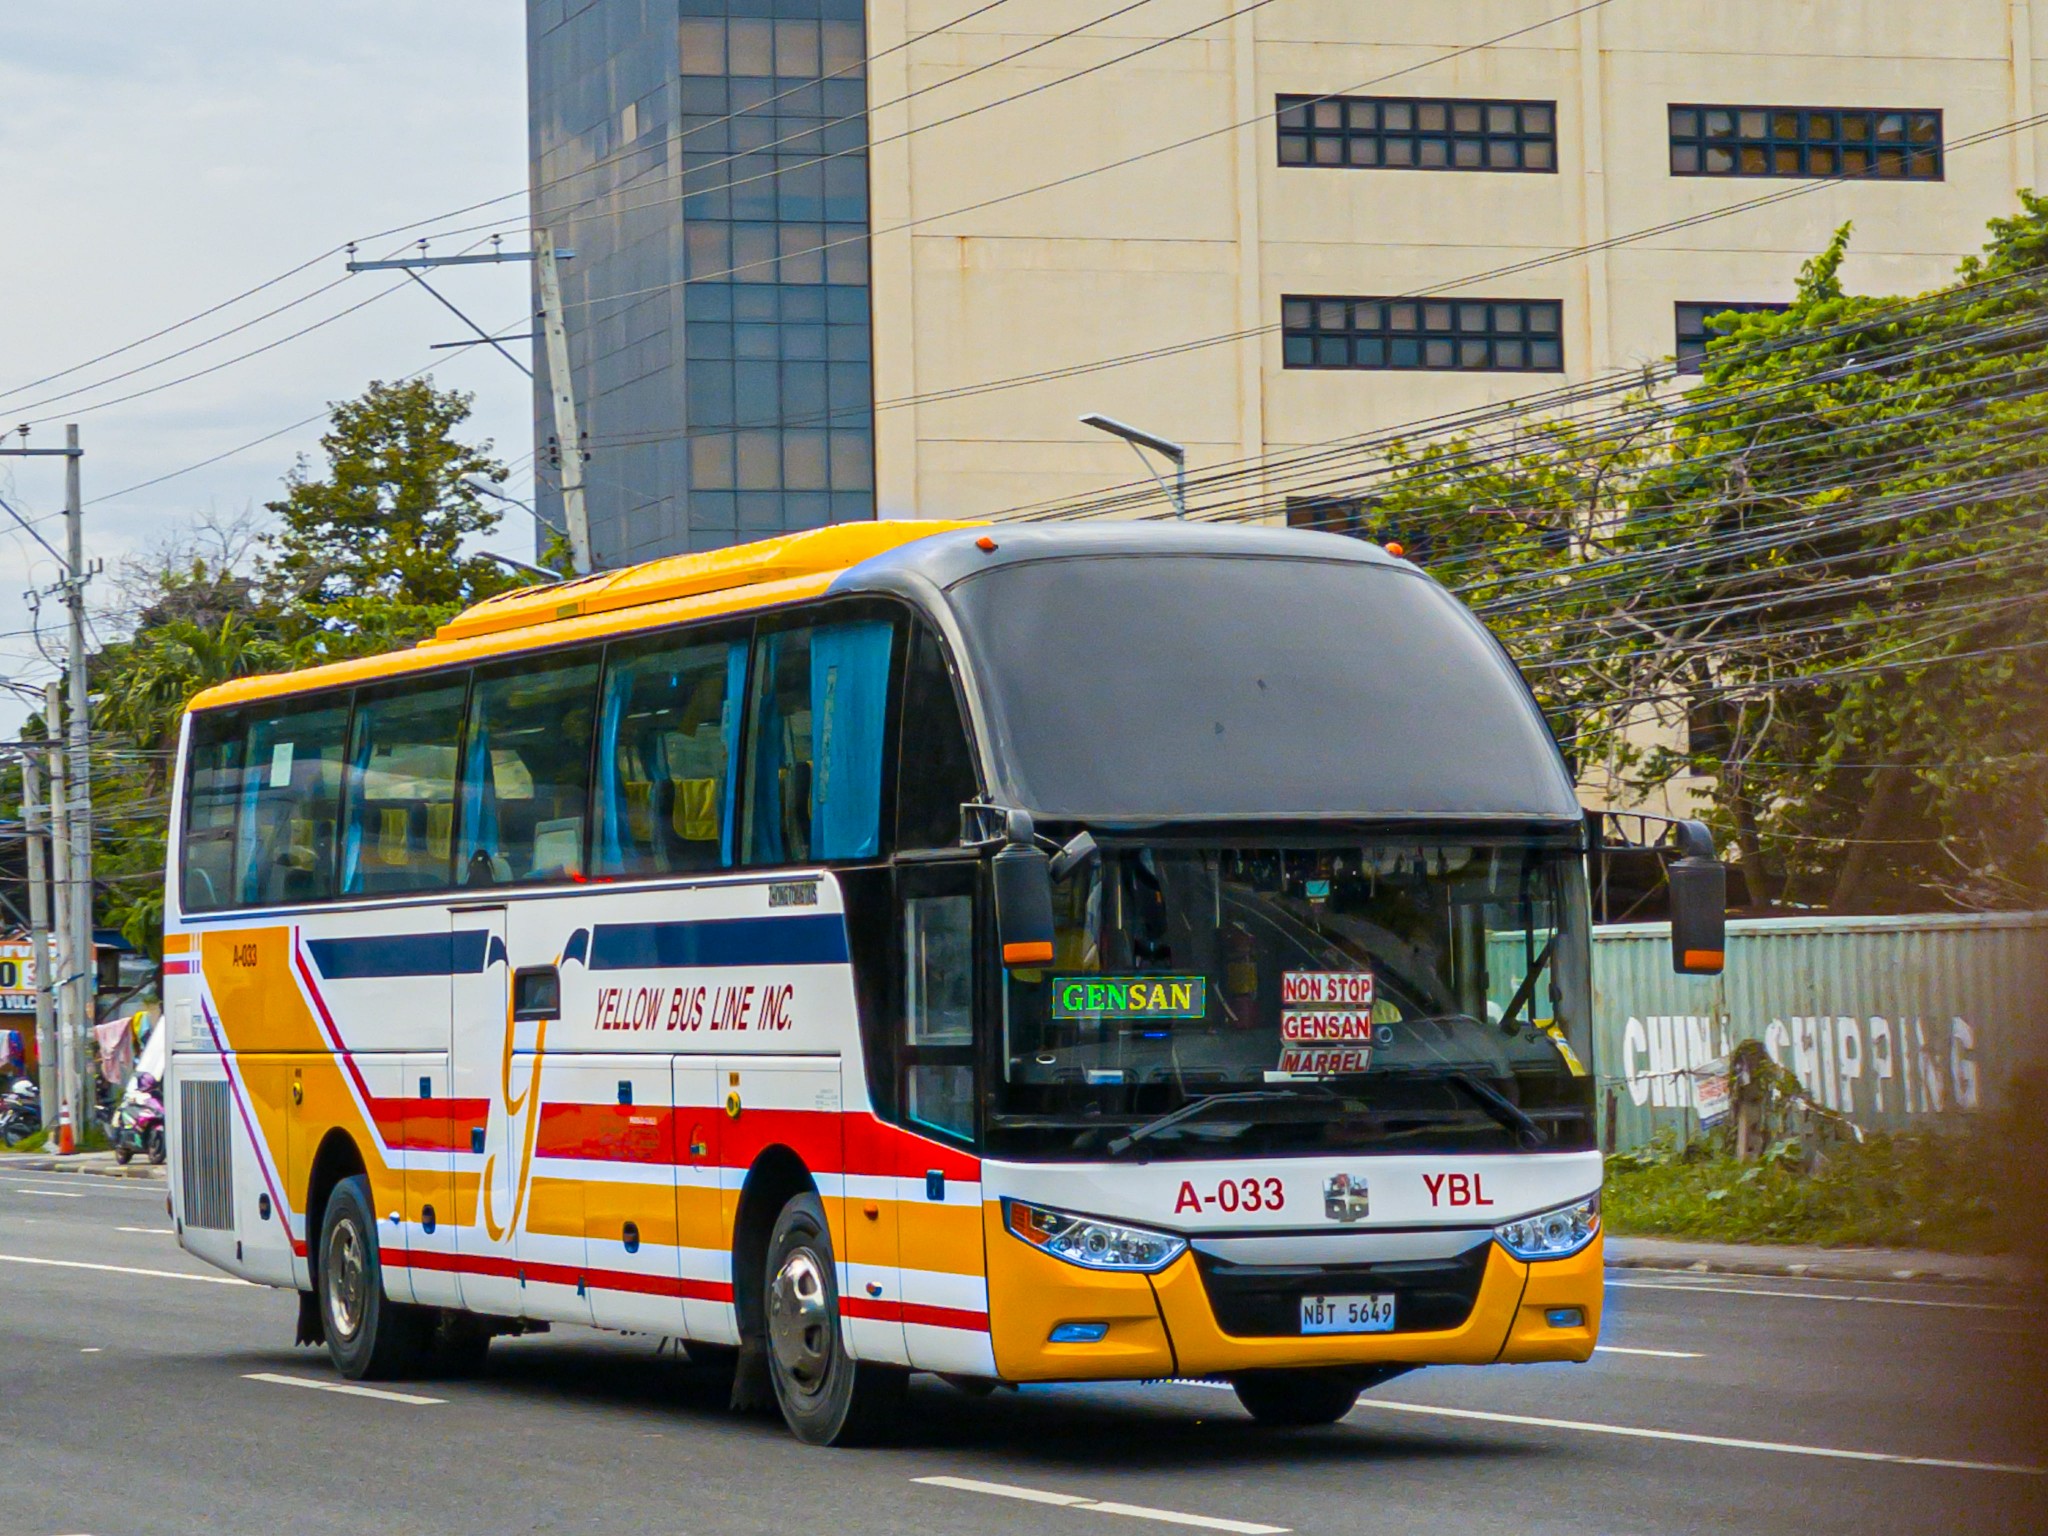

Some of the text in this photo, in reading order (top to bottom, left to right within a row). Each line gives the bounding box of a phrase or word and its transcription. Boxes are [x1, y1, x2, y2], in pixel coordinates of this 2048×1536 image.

[232, 944, 257, 967] A-033
[1062, 983, 1193, 1011] GENSAN
[1285, 977, 1370, 1001] NON STOP
[594, 984, 793, 1031] YELLOW BUS LINE INC.
[1284, 1016, 1370, 1039] GENSAN
[1282, 1053, 1366, 1073] MARBEL
[1174, 1177, 1285, 1214] A-033
[1422, 1173, 1494, 1207] YBL
[1303, 1302, 1392, 1325] NBT 5649
